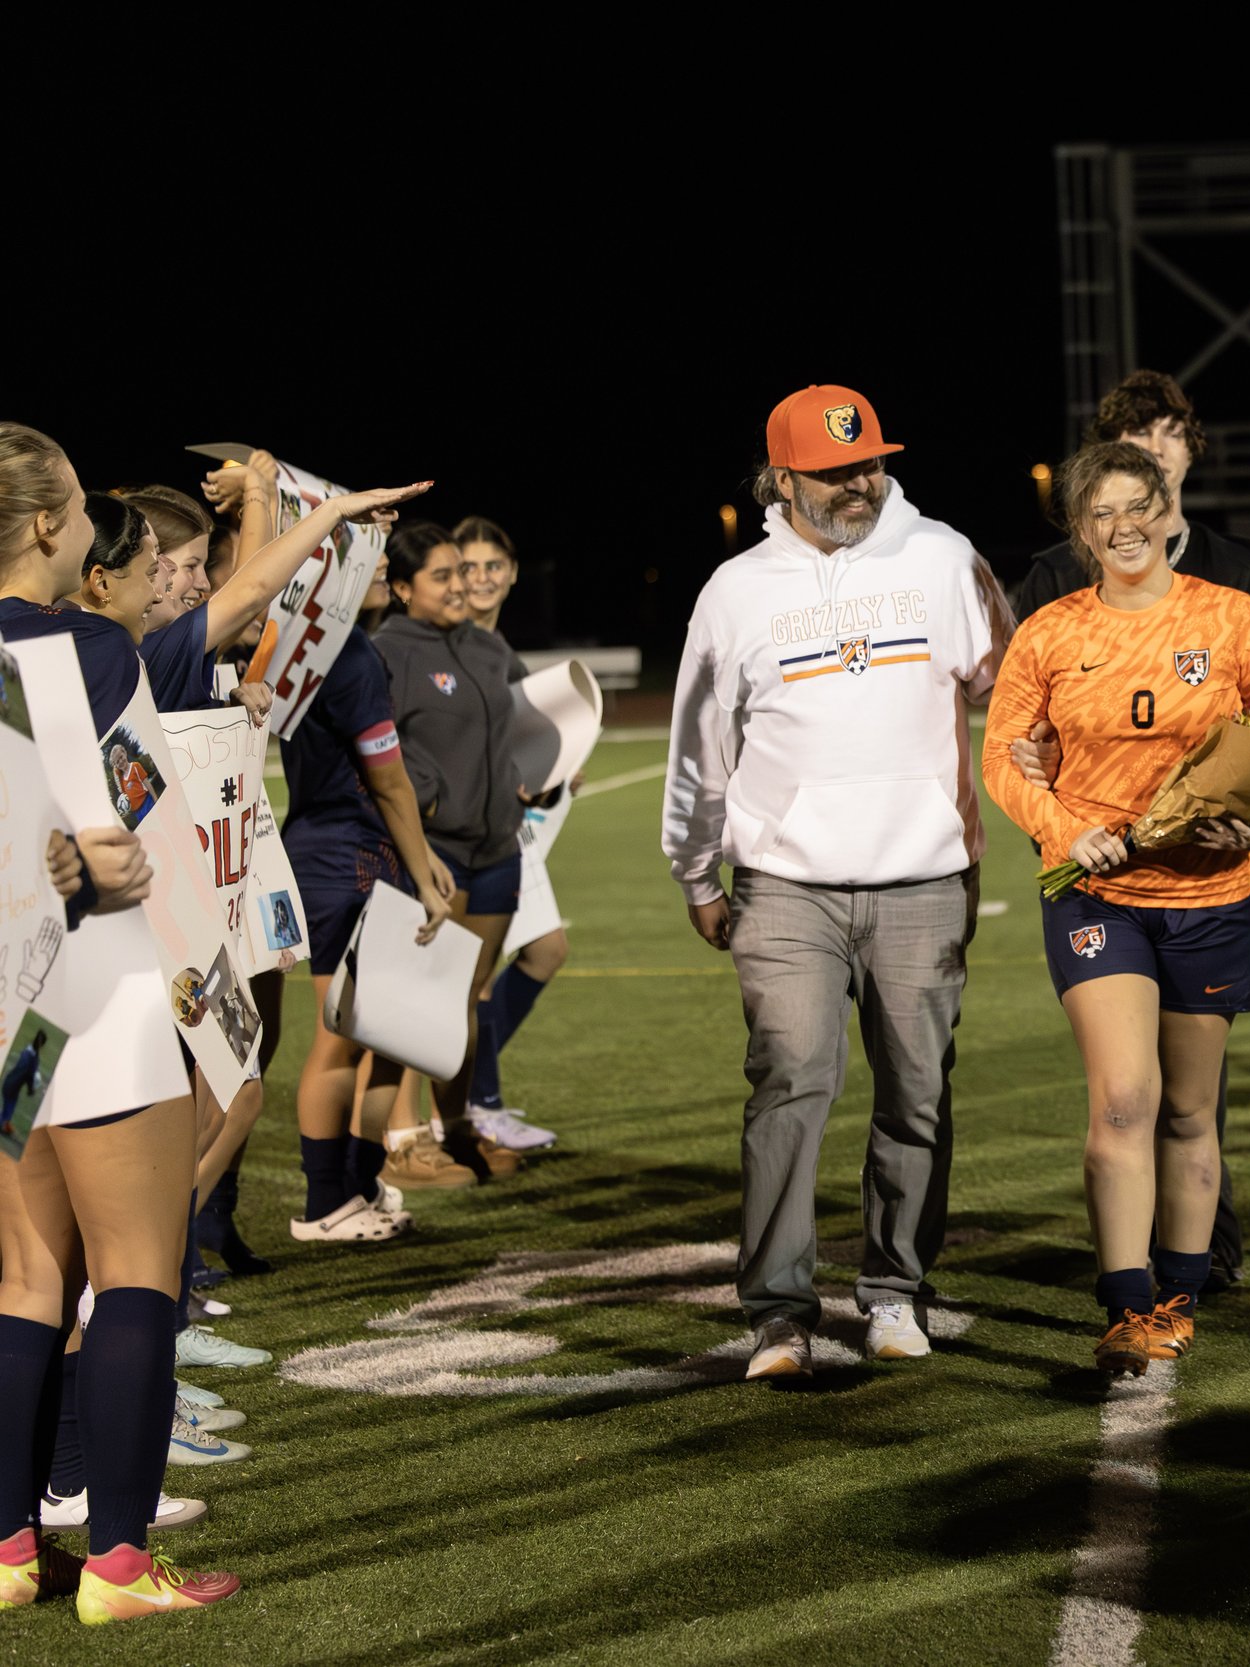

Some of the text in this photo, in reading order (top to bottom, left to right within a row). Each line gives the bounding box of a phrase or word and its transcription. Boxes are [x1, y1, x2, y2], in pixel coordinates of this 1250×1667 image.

[771, 589, 927, 646] GRIZZLY FC
[1131, 690, 1155, 729] 0
